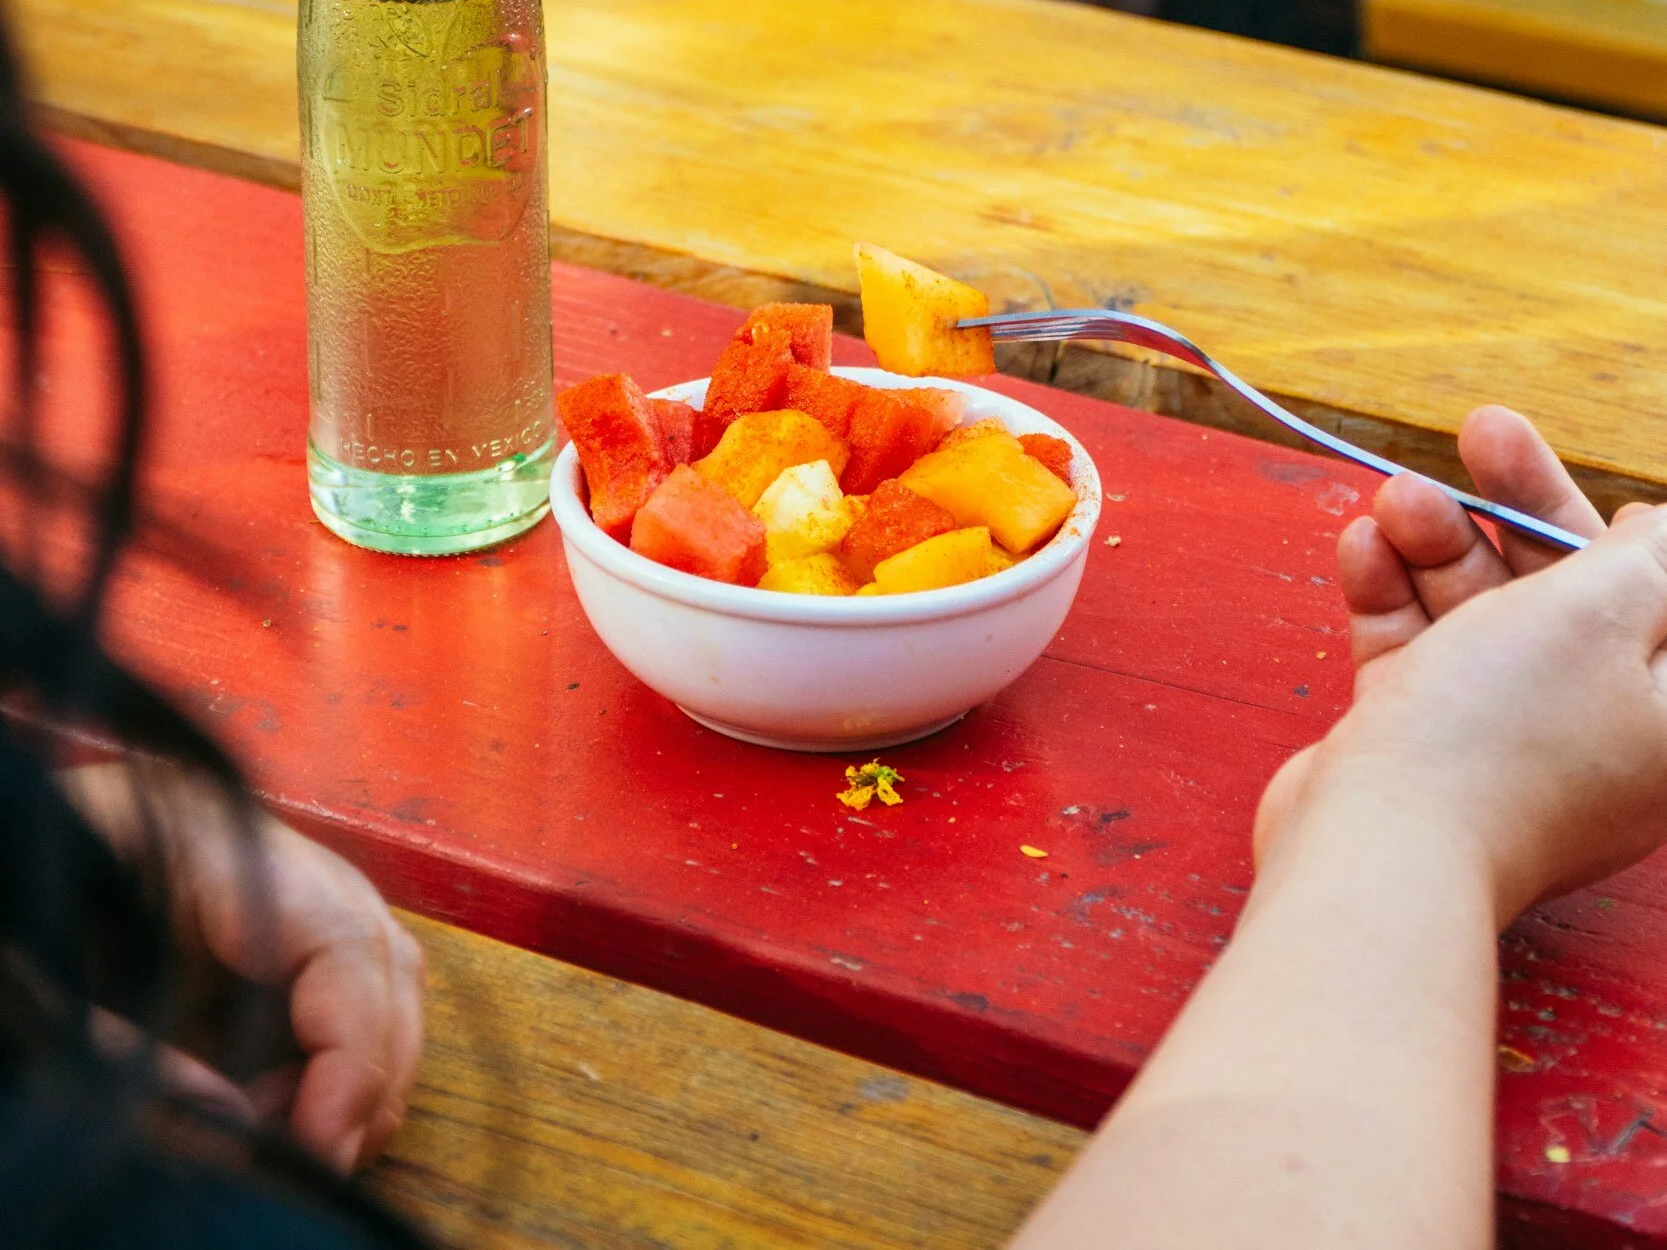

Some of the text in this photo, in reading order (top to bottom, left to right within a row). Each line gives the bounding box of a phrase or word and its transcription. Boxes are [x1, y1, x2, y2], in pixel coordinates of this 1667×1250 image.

[337, 107, 532, 175] MUNDET
[340, 437, 415, 467] HECHO
[429, 449, 458, 468] EN
